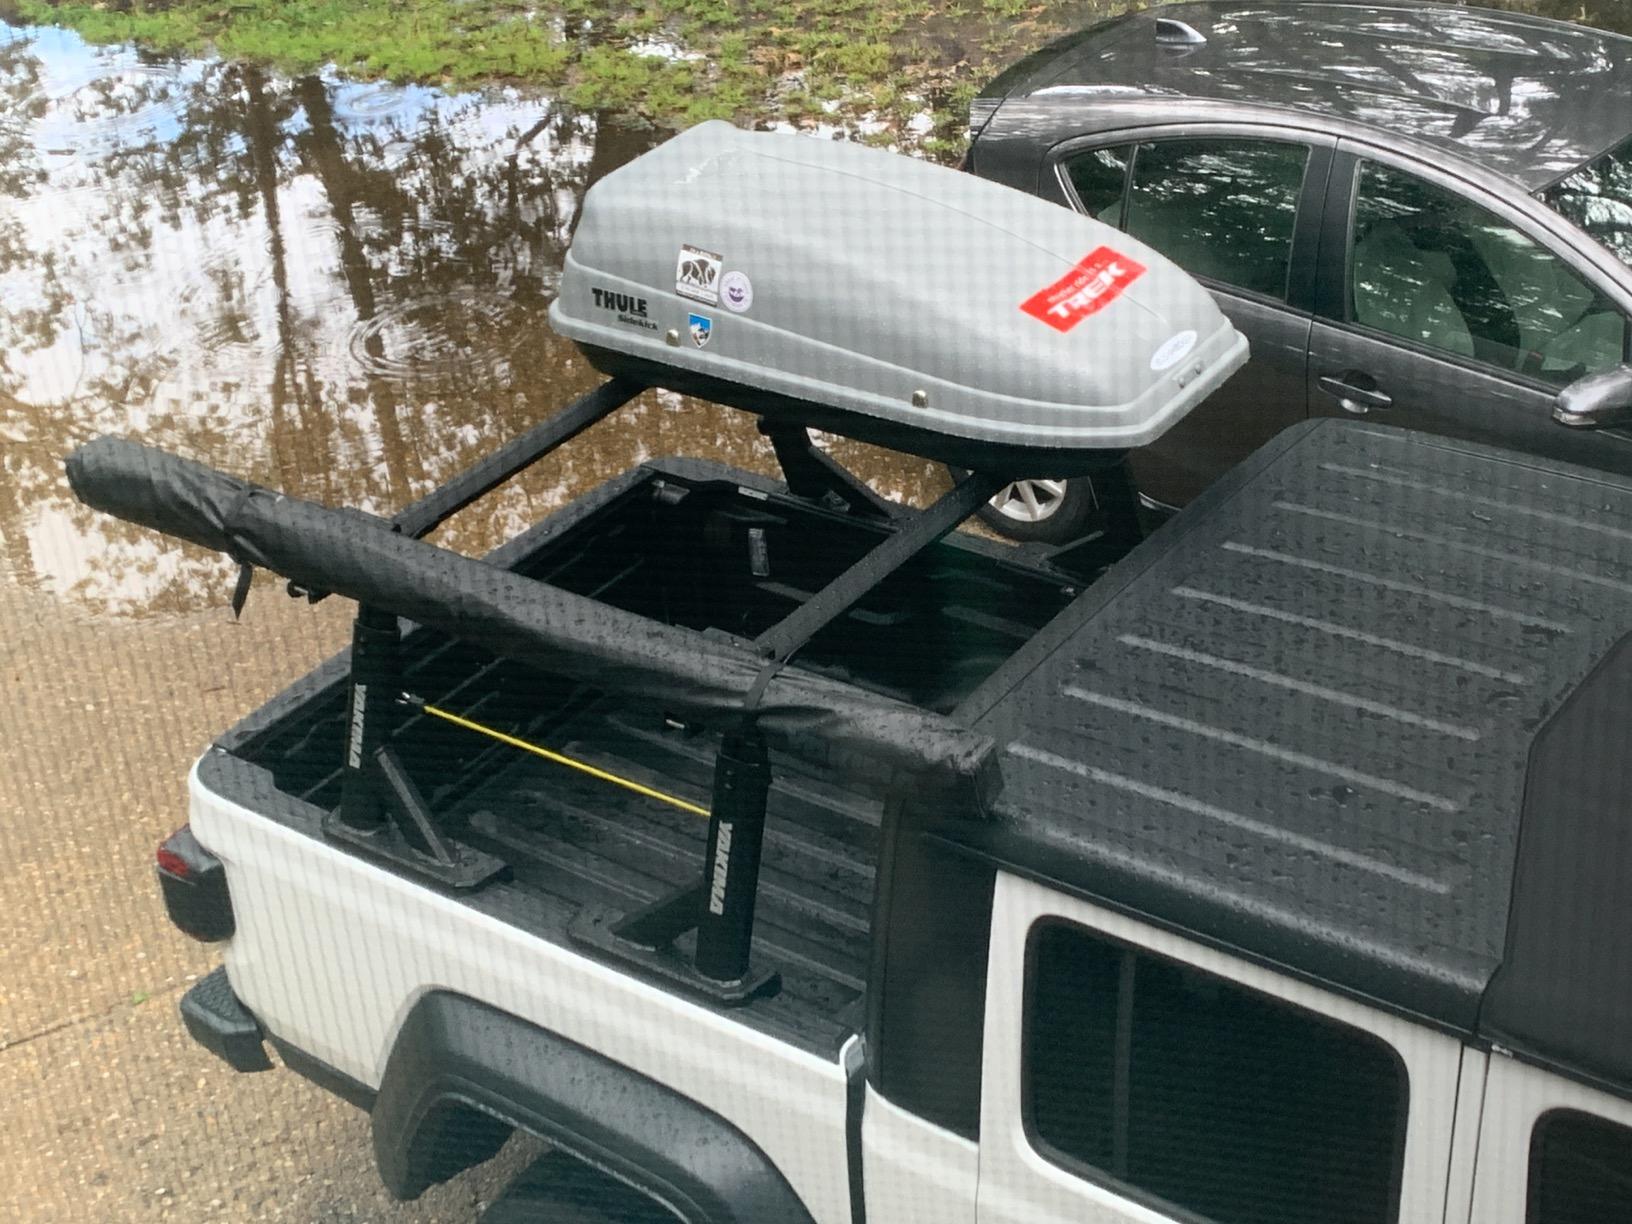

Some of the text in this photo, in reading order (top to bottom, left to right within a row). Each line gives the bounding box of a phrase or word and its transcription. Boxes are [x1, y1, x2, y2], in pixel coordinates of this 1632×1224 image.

[592, 287, 648, 314] THULE
[1047, 261, 1126, 318] TREK
[349, 682, 367, 769] YAKIMA
[709, 820, 733, 915] YAKIMA
